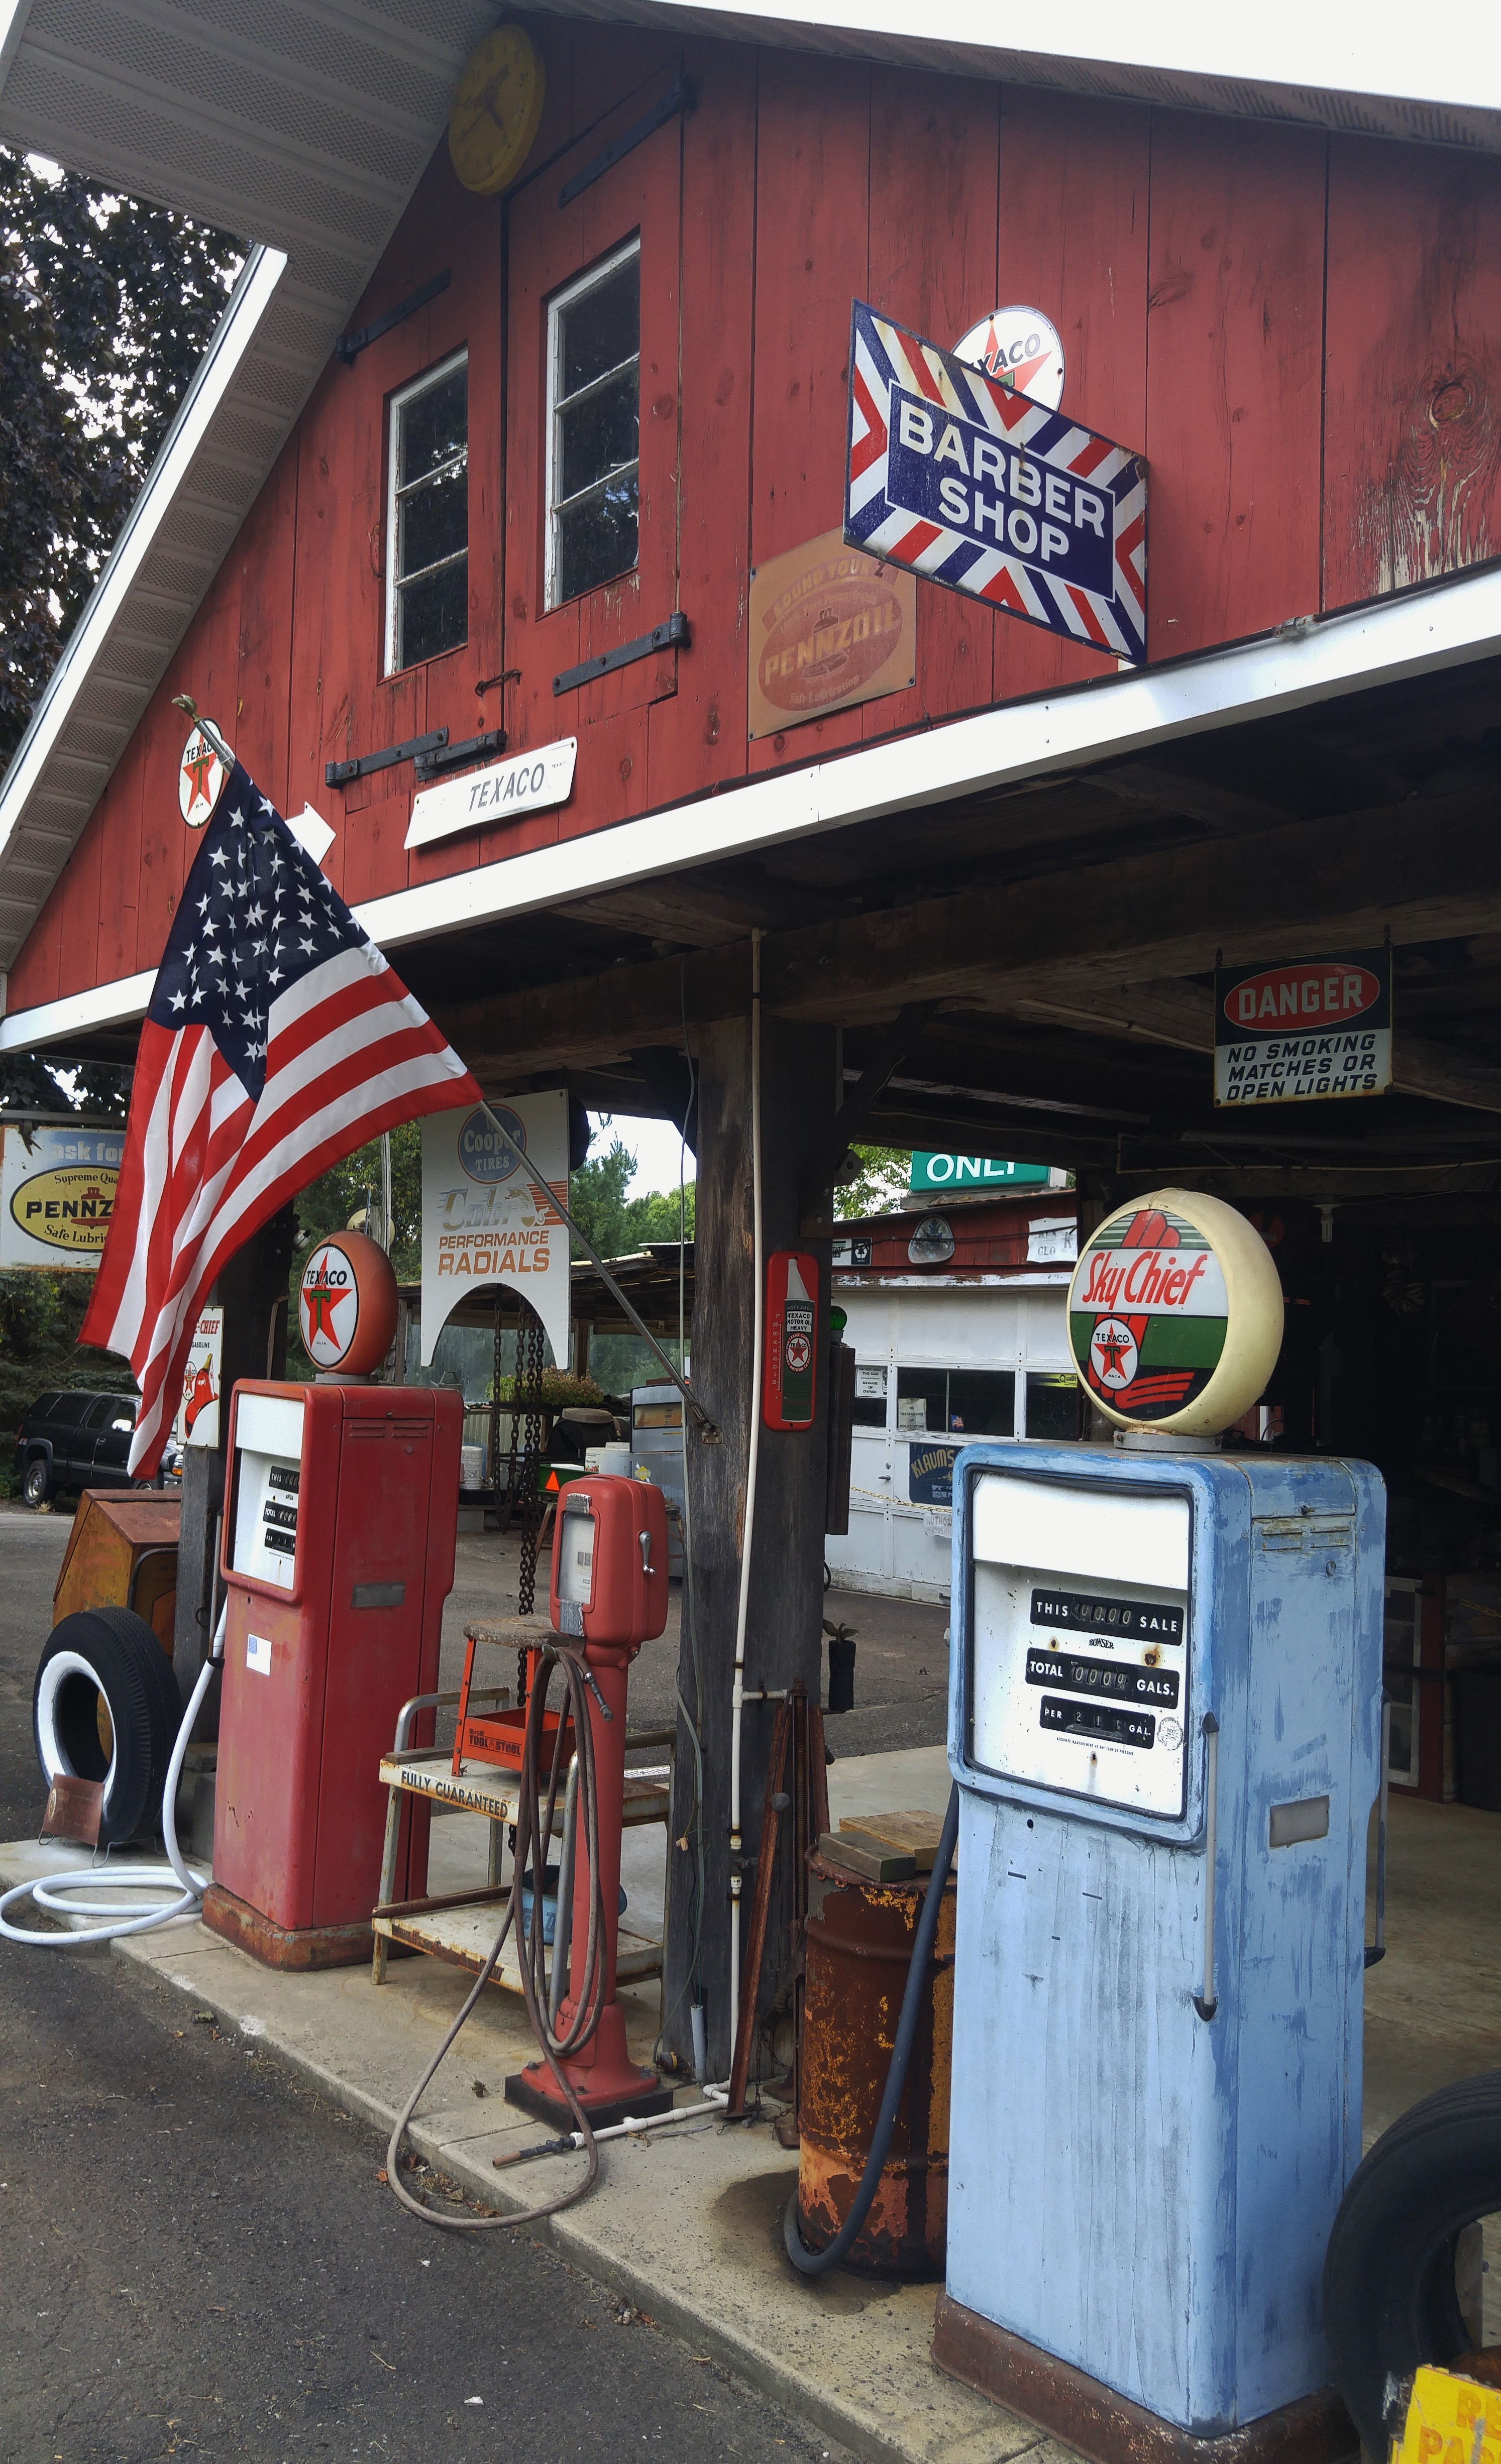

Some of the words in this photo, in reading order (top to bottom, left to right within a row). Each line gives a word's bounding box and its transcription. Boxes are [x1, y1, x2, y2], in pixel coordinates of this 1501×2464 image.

[970, 334, 1040, 376] XACO
[899, 399, 1105, 538] BARBER
[938, 477, 1069, 562] SHOP
[774, 569, 824, 618] SOUND
[829, 558, 871, 579] YOUR
[765, 600, 900, 685] PENNZOIL
[186, 742, 212, 763] TEXAC
[469, 763, 545, 811] TEXACO
[1239, 974, 1363, 1021] DANGER
[1227, 1046, 1256, 1063] NO
[1265, 1034, 1375, 1060] SMOKING
[1228, 1057, 1333, 1082] MATCHES
[1342, 1054, 1375, 1072] OR
[1226, 1081, 1285, 1100] OPEN
[1294, 1073, 1377, 1095] LIGHTS
[52, 1141, 91, 1161] ask
[475, 1156, 509, 1171] TIRES
[54, 1174, 98, 1184] Supreme
[26, 1199, 115, 1219] PENNZ
[44, 1224, 70, 1240] Safe
[440, 1230, 550, 1250] PERFORMANCE
[438, 1248, 550, 1276] RADIALS
[306, 1270, 347, 1286] TEXACO
[1082, 1252, 1126, 1310] Sky
[1124, 1251, 1208, 1305] Chief
[1096, 1333, 1129, 1343] TEXACO
[911, 1447, 954, 1478] KLAUM'S
[271, 1473, 282, 1482] THIS
[265, 1508, 276, 1517] TOTAL
[926, 1516, 952, 1527] AUTHOR
[1037, 1602, 1068, 1617] THIS
[1140, 1616, 1177, 1632] SALE
[1089, 1638, 1114, 1649] BOWSER
[1030, 1661, 1063, 1676] TOTAL
[1136, 1679, 1174, 1696] GALS.
[1044, 1708, 1061, 1719] PER
[1129, 1725, 1151, 1736] GAL.
[469, 1735, 488, 1747] TOOL
[402, 1770, 431, 1791] FULLY
[436, 1781, 508, 1819] GUARANTEED
